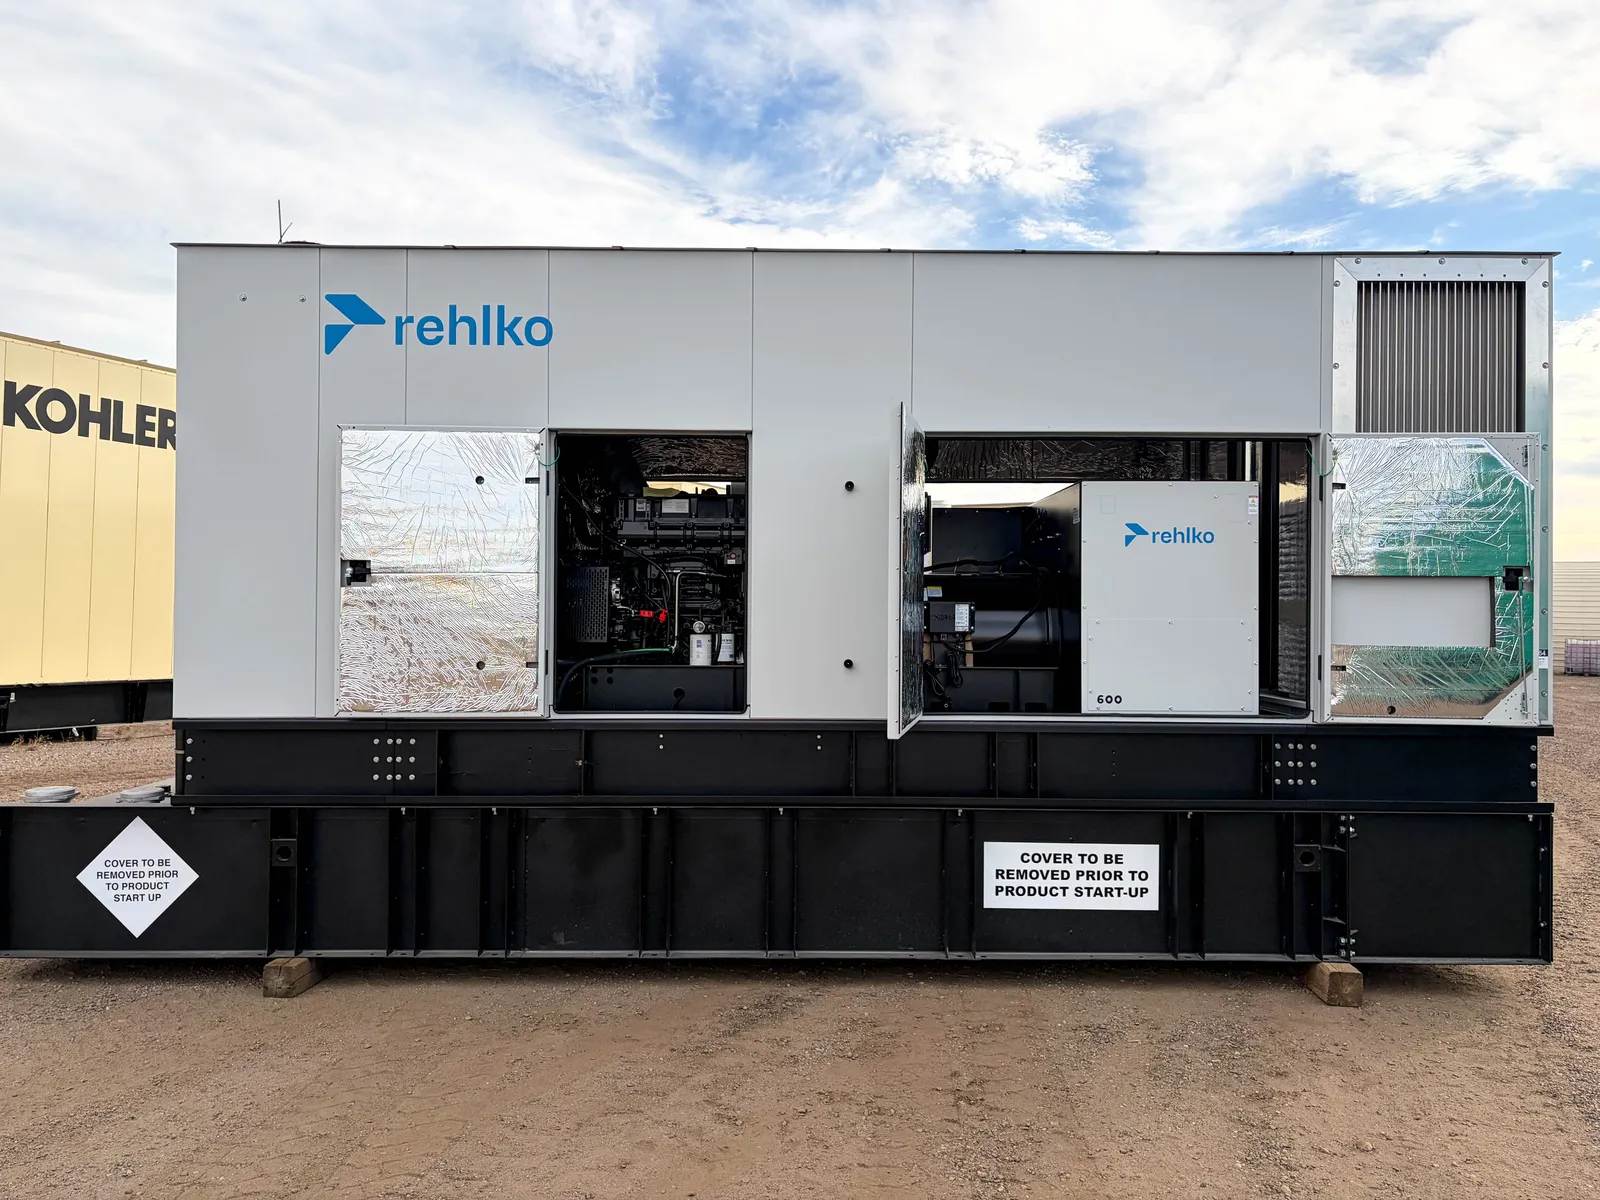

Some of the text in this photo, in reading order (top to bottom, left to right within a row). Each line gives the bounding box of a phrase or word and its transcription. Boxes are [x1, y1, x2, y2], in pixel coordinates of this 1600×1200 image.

[394, 304, 554, 347] rehlko
[3, 380, 176, 451] KOHLER
[1151, 526, 1215, 545] rehlko
[1096, 694, 1123, 705] 600
[104, 858, 171, 868] COVER TO BE
[1020, 852, 1124, 865] COVER TO BE
[96, 869, 179, 880] REMOVED PRIOR
[995, 868, 1149, 882] REMOVED PRIOR TO
[105, 881, 170, 891] TO PRODUCT
[994, 885, 1149, 898] PRODUCT START-UP
[113, 893, 162, 903] START UP
